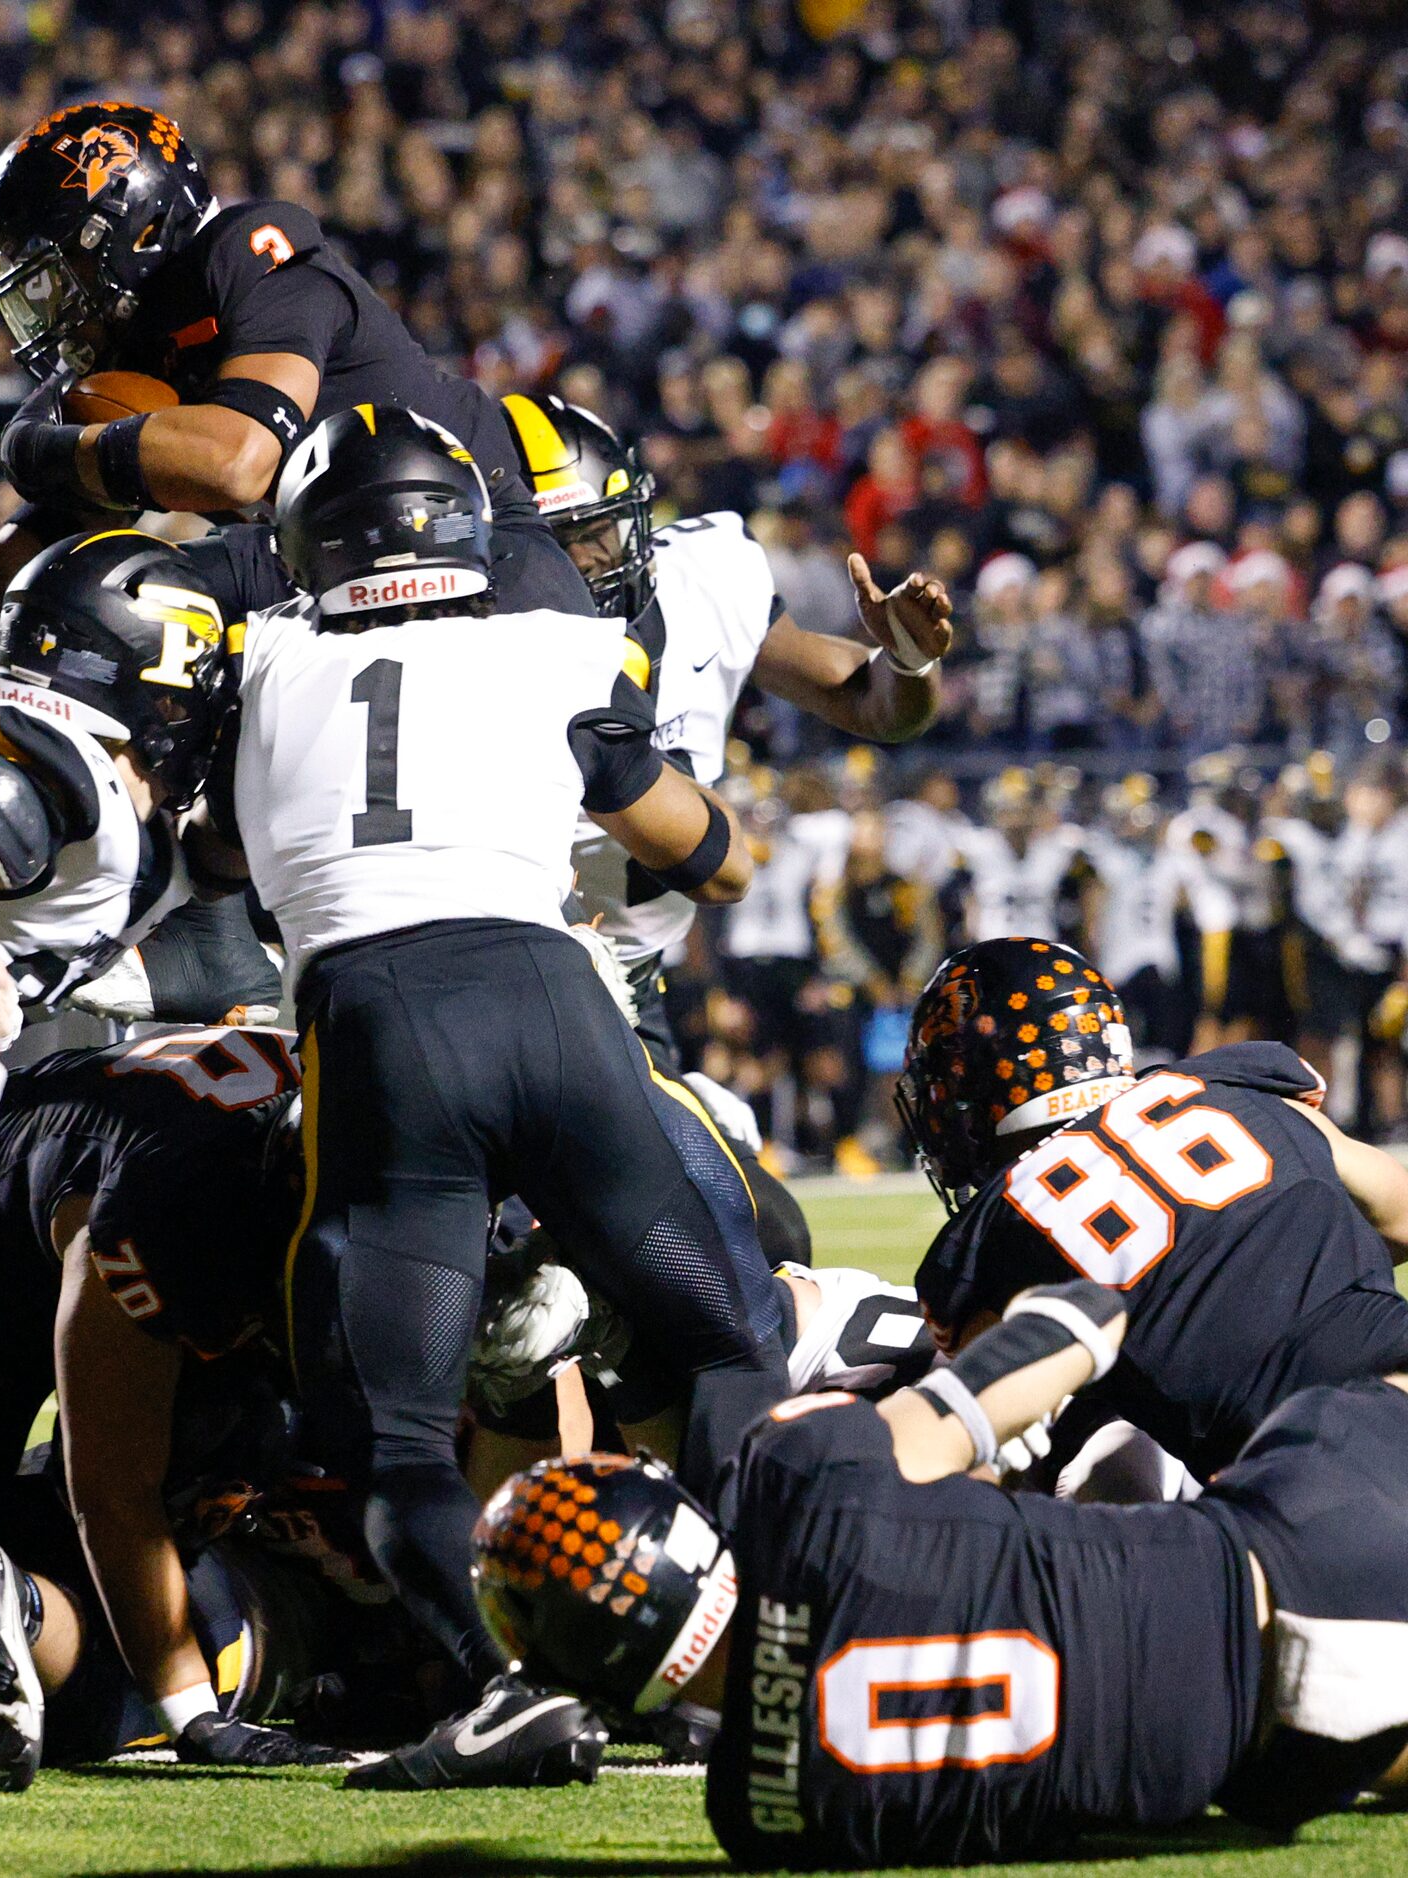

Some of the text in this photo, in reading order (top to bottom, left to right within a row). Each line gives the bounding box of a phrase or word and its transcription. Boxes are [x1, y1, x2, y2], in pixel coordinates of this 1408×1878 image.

[537, 487, 586, 508] Riddell
[349, 575, 455, 606] Riddell
[350, 658, 413, 849] 1
[1075, 1012, 1101, 1034] 86
[1002, 1071, 1274, 1291] 86
[91, 1237, 163, 1320] 70
[661, 1573, 737, 1688] Riddell
[748, 1596, 812, 1834] GILLESPIE
[817, 1629, 1060, 1774] 0
